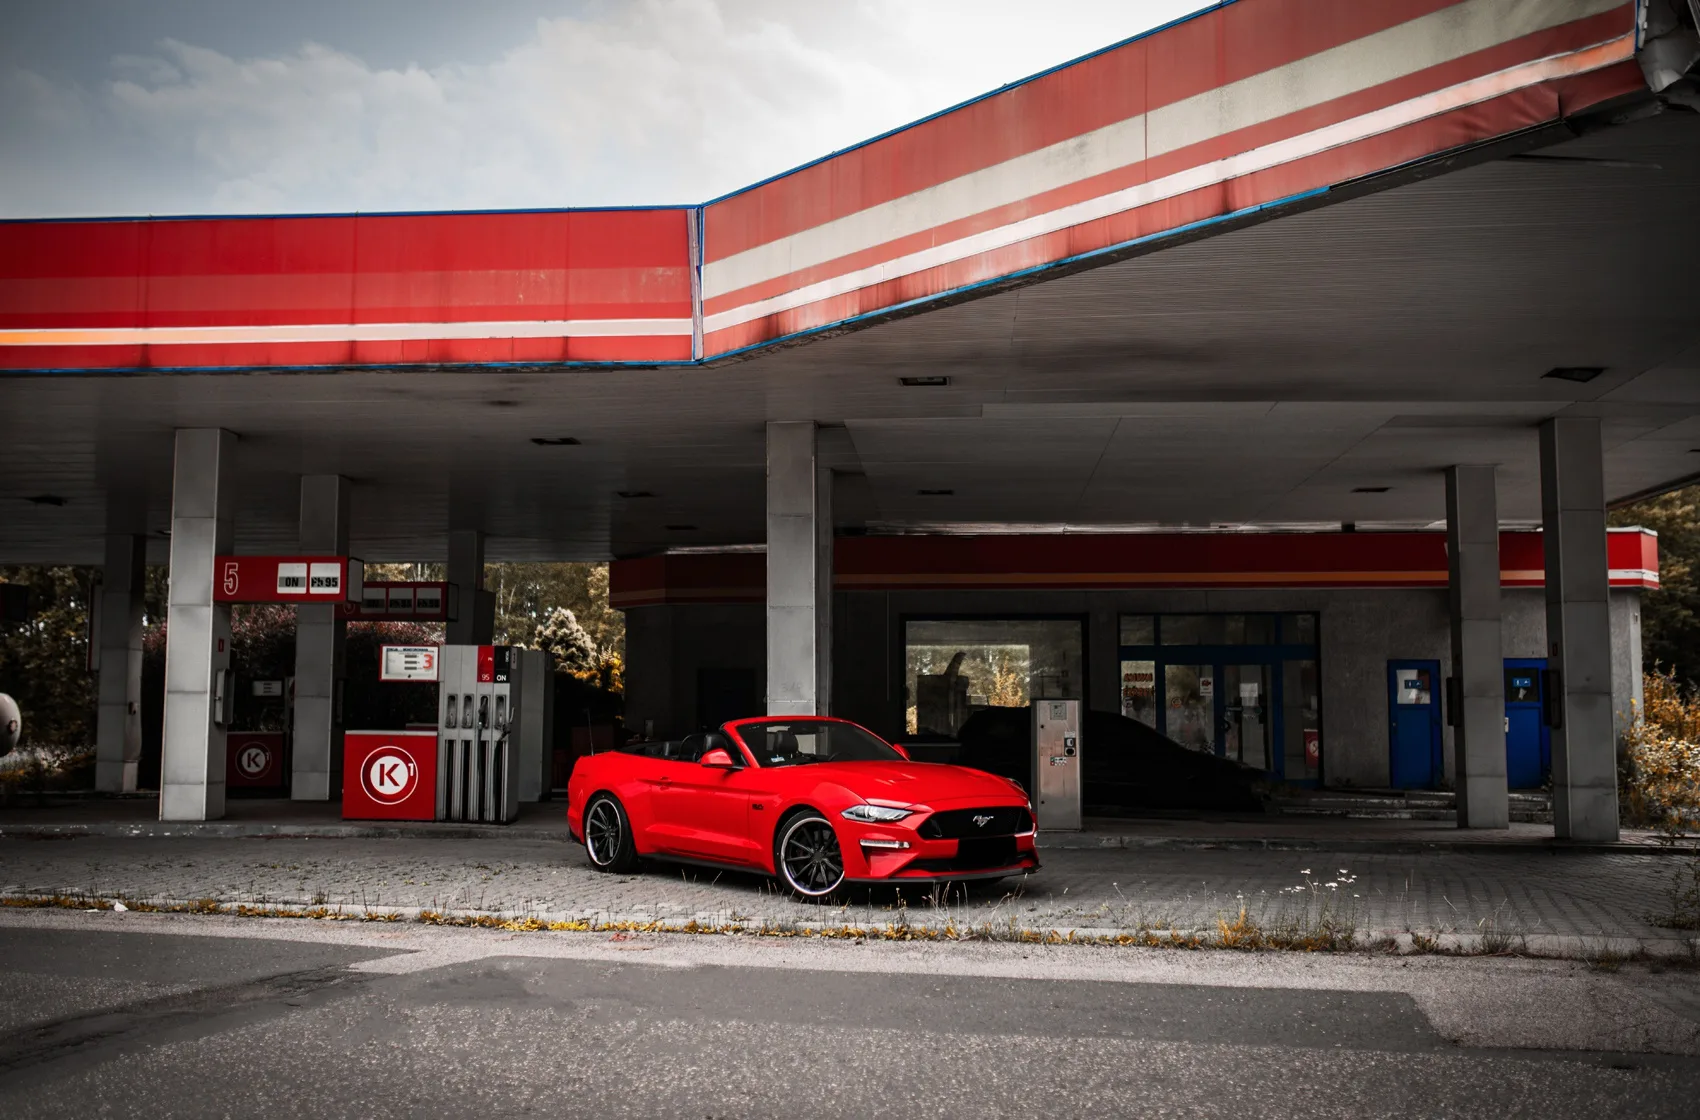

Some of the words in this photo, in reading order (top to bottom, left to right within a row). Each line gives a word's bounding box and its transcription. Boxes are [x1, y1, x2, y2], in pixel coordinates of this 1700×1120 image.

[223, 562, 239, 596] 5
[285, 577, 299, 587] ON
[423, 653, 433, 670] 3
[481, 673, 490, 681] 95
[247, 752, 260, 768] K
[379, 763, 400, 787] K
